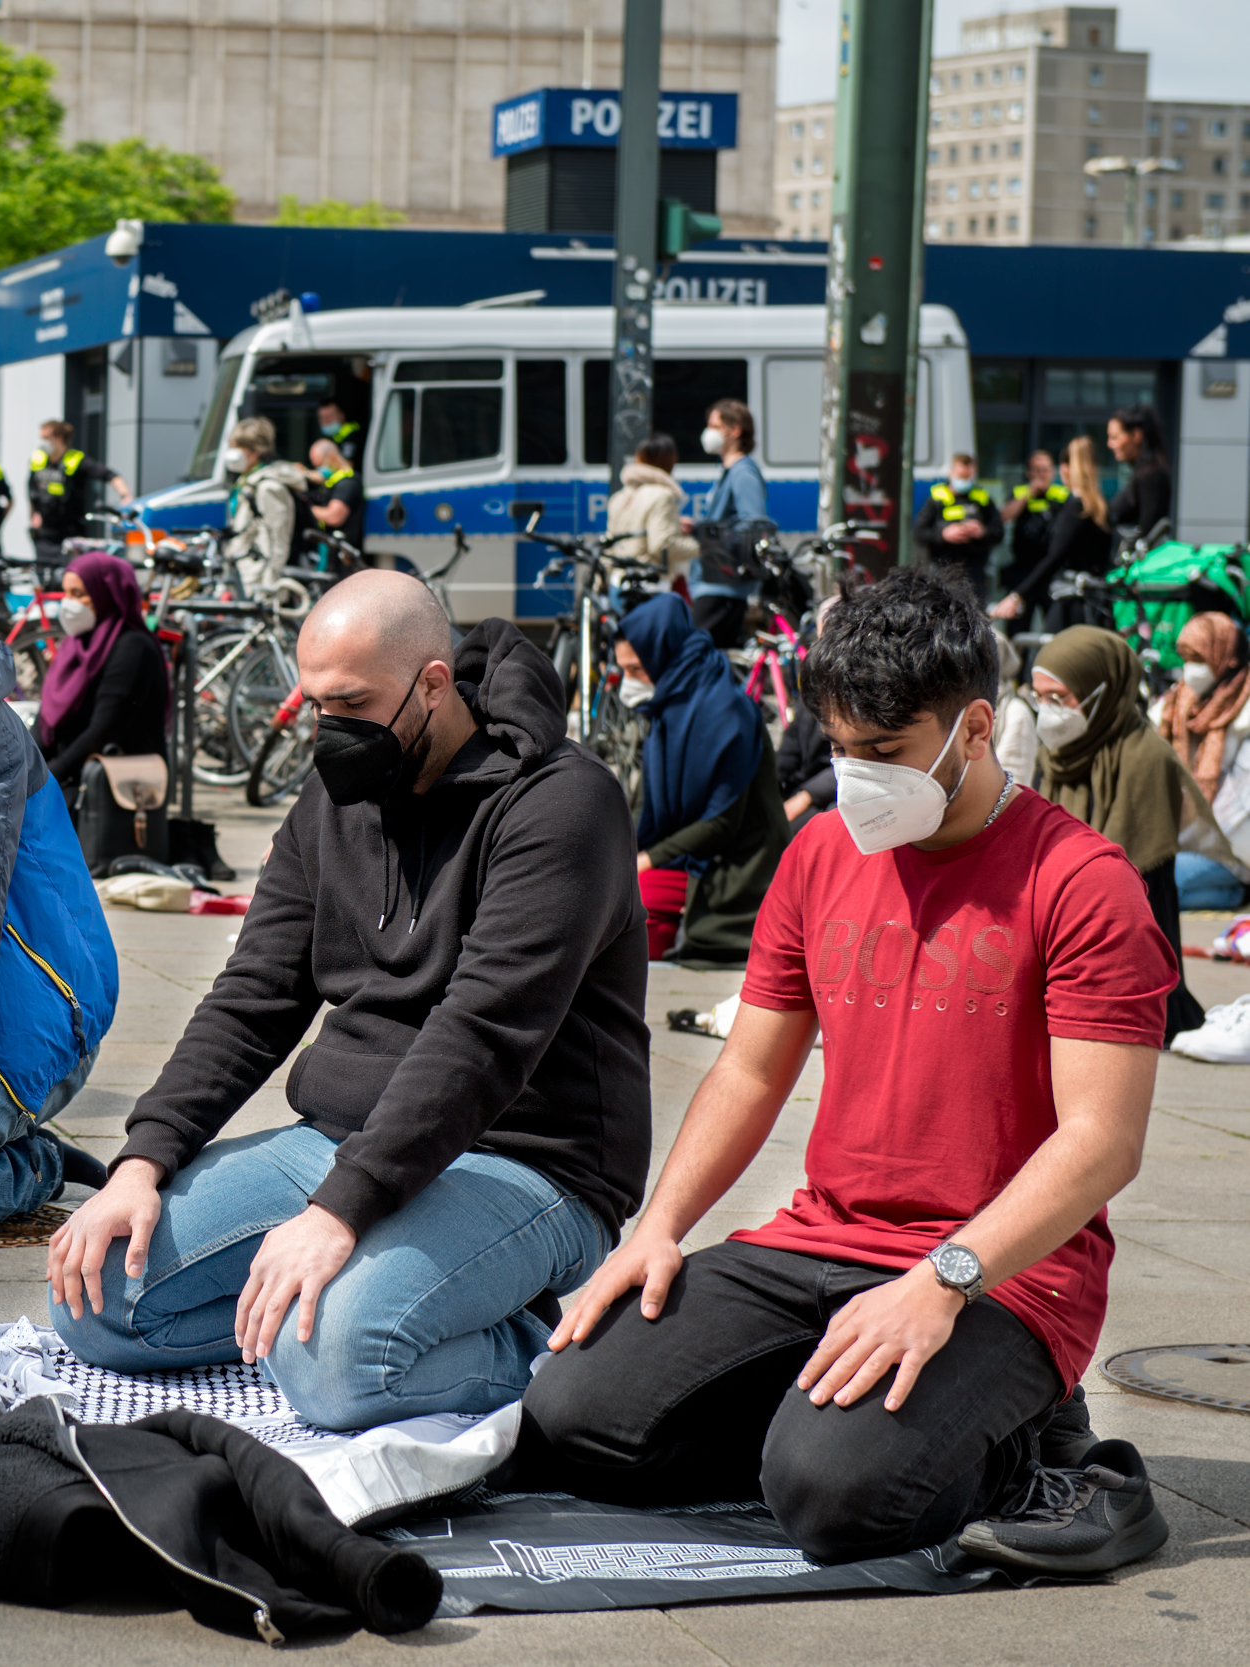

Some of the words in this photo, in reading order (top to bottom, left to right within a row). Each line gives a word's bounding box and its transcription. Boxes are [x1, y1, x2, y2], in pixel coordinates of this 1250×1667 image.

[570, 98, 713, 139] POZEI
[814, 919, 1016, 995] BOSS
[911, 994, 1009, 1017] BOSS
